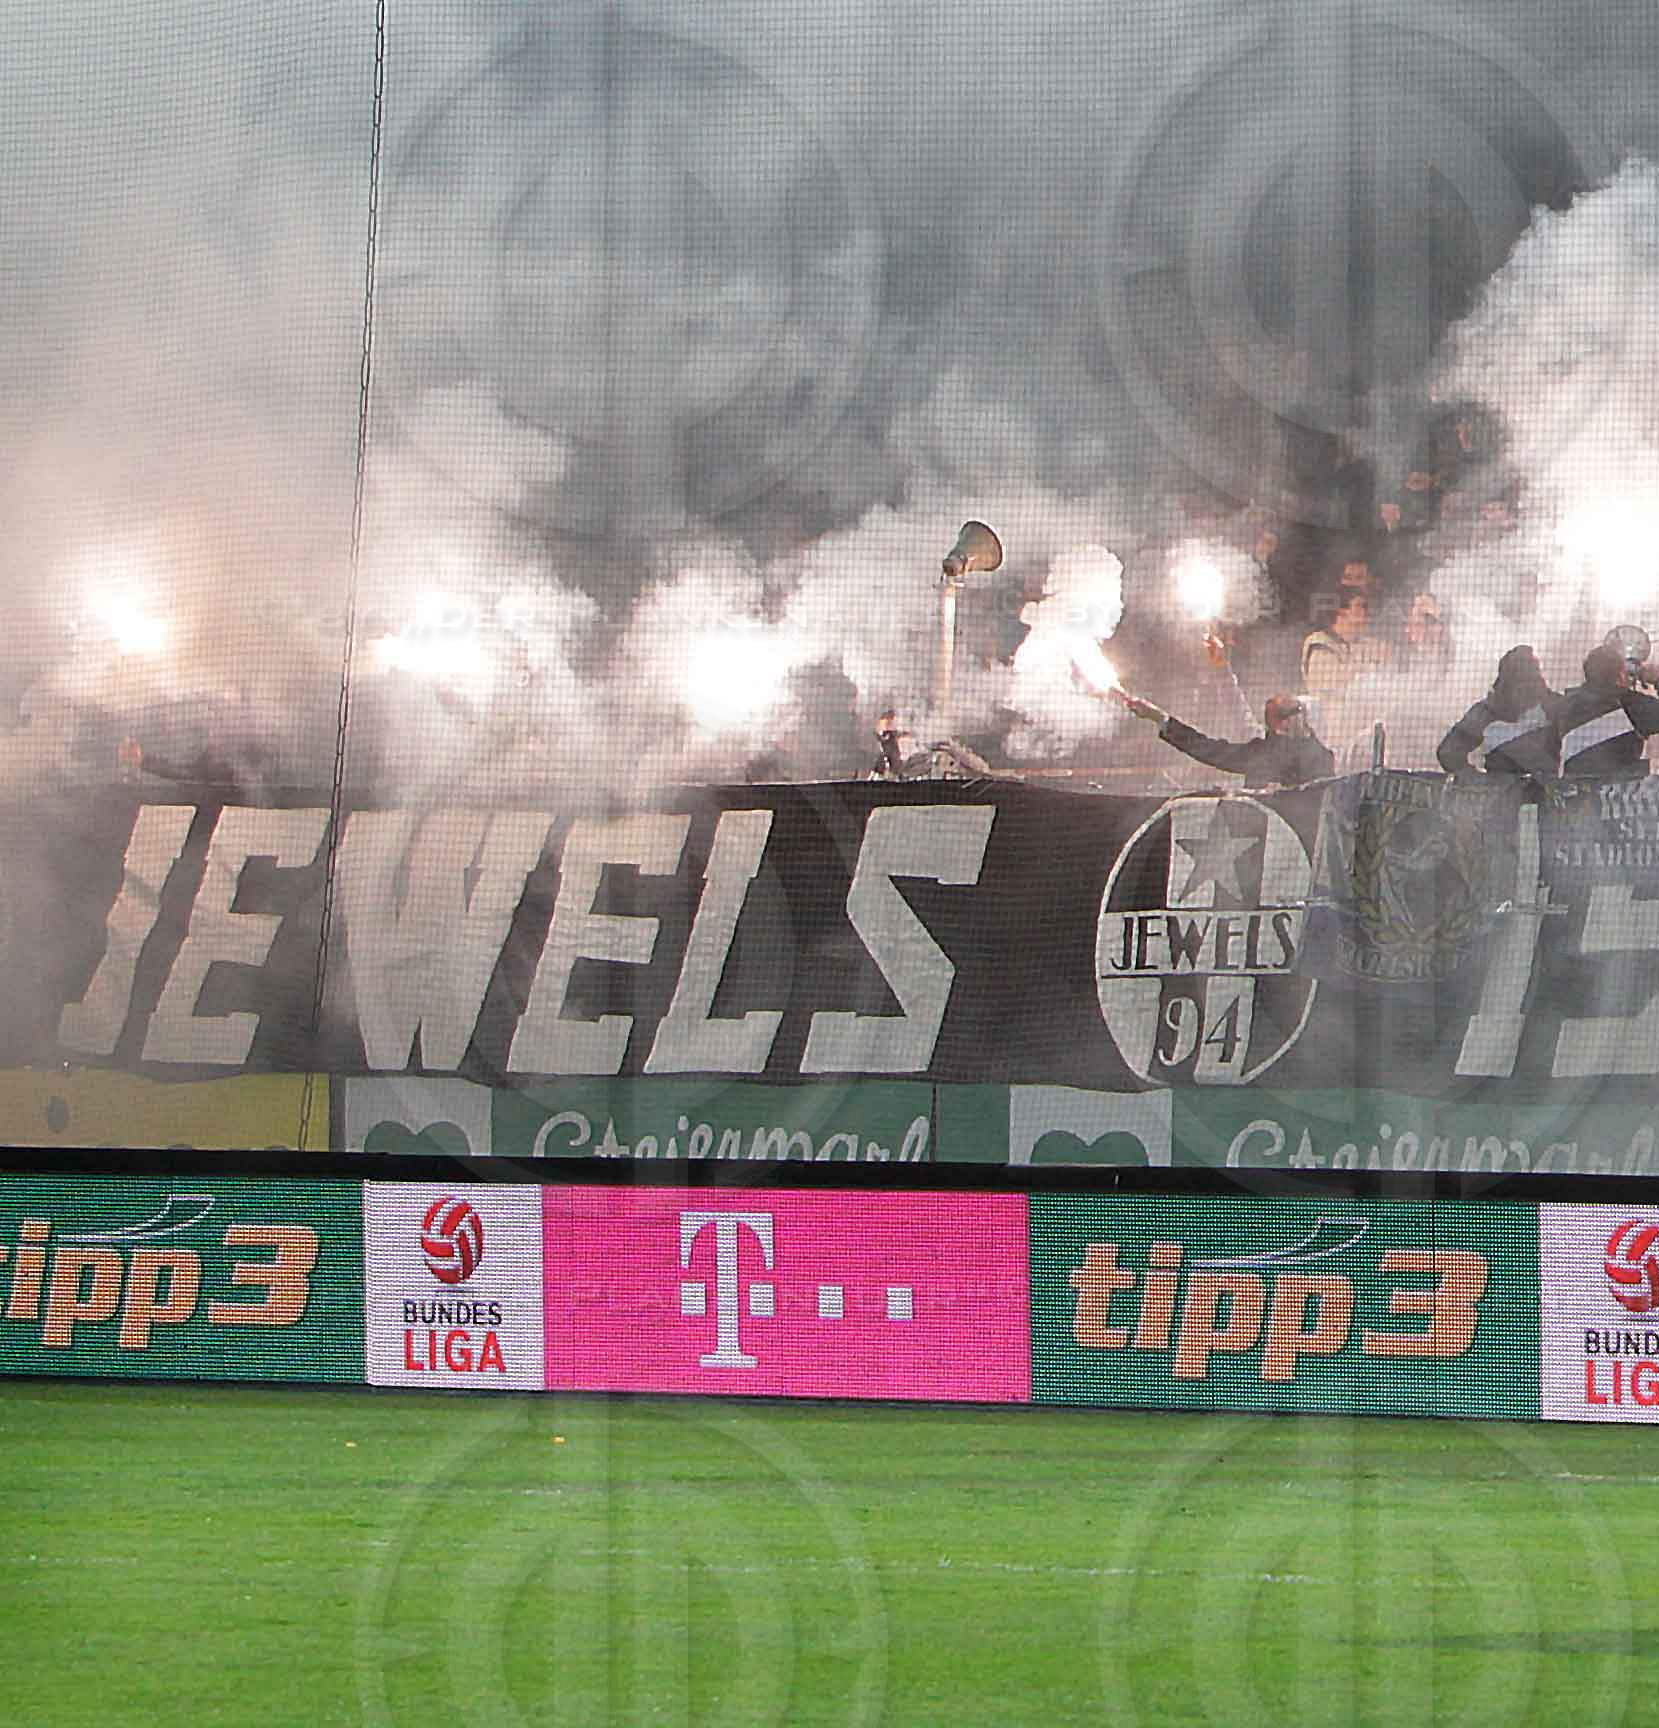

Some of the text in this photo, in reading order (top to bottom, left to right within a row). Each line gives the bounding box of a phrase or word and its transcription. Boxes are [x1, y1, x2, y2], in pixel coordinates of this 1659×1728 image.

[57, 803, 997, 1077] JEWELS
[1108, 911, 1297, 972] JEWELS
[1157, 994, 1242, 1067] 94
[403, 1300, 503, 1327] BUNDES
[1068, 1237, 1490, 1381] tipp3
[403, 1329, 507, 1374] LIGA
